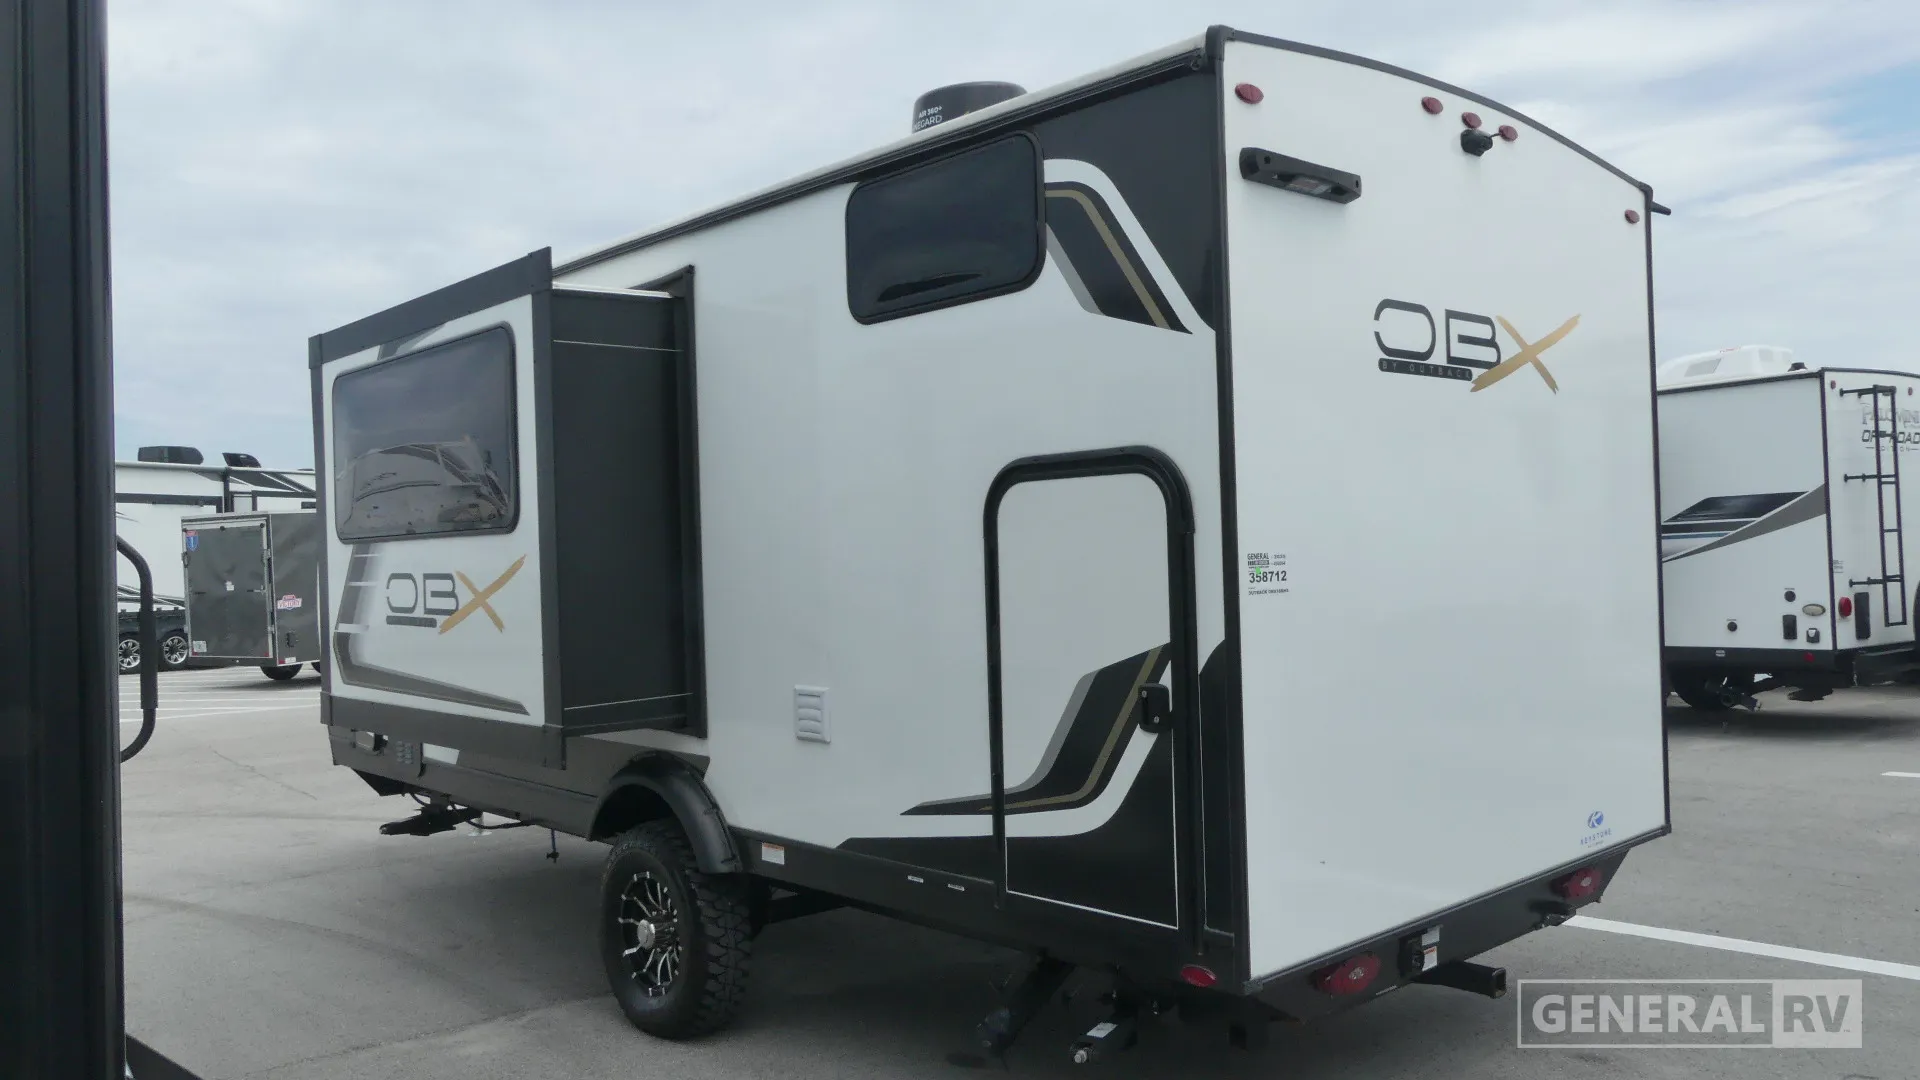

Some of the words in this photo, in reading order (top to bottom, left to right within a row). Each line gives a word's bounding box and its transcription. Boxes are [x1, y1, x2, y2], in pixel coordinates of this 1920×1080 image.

[1373, 298, 1581, 395] OBX
[1382, 360, 1397, 371] BY
[1409, 363, 1471, 380] OUTBACK
[386, 554, 526, 635] OBX
[1249, 571, 1287, 583] 358712
